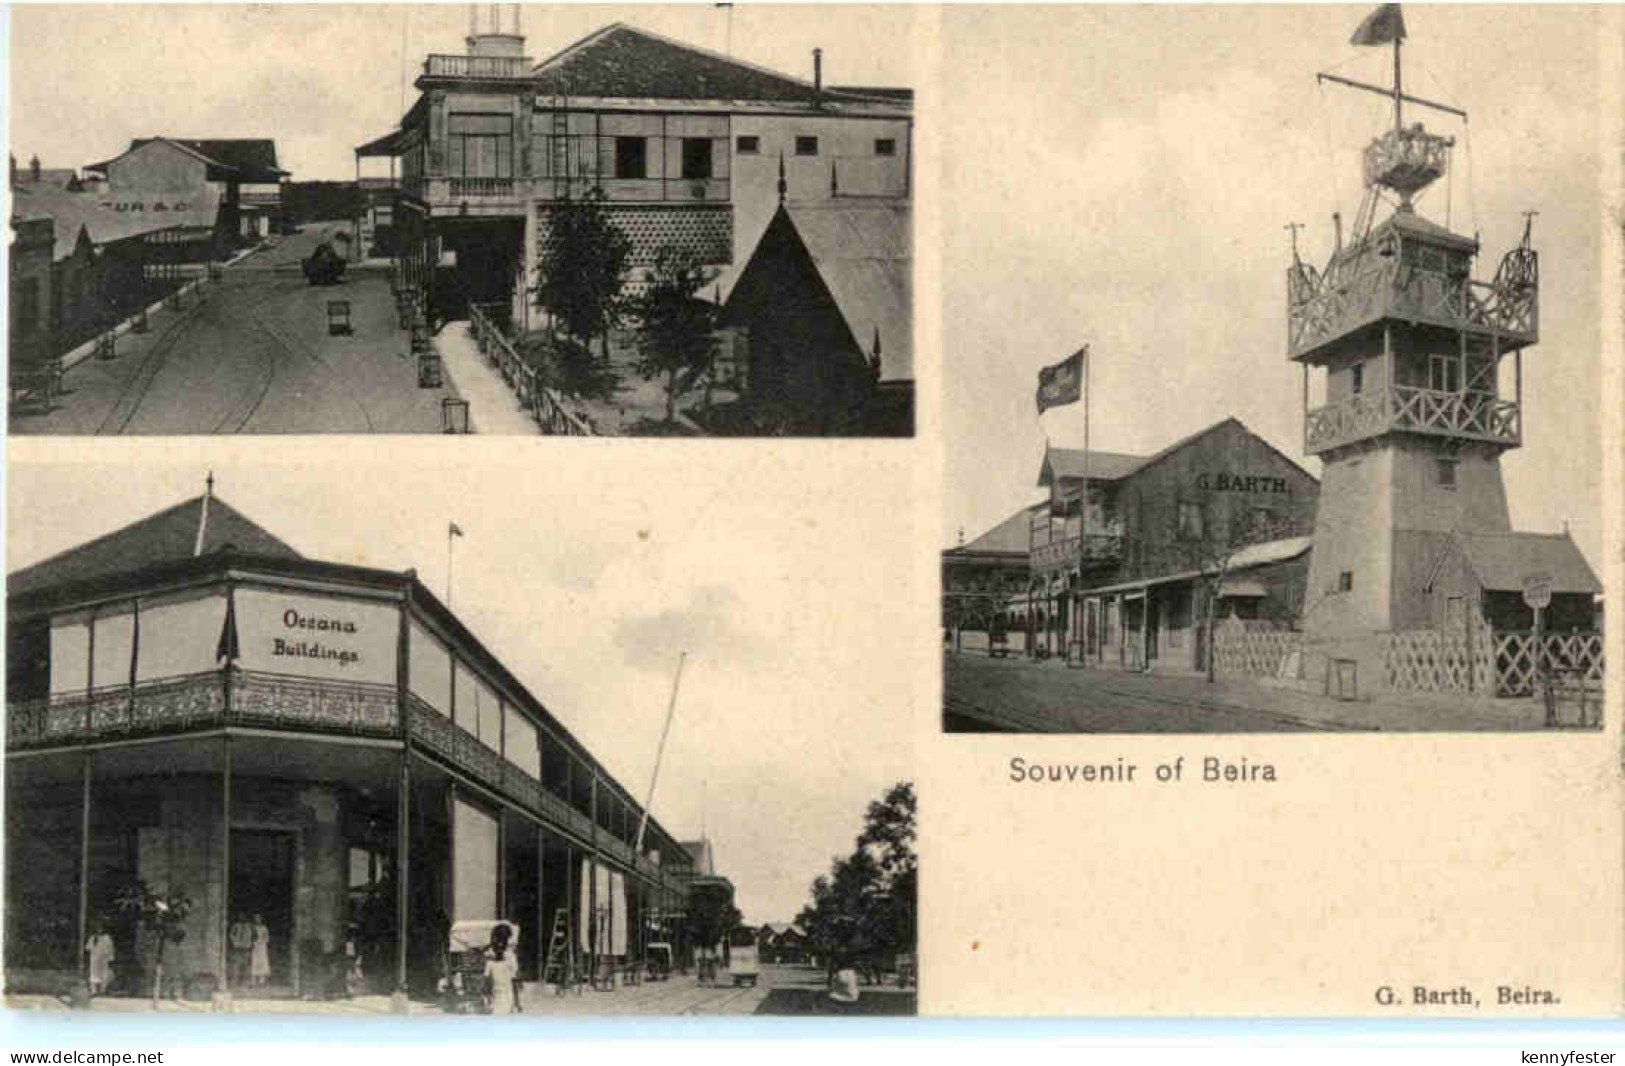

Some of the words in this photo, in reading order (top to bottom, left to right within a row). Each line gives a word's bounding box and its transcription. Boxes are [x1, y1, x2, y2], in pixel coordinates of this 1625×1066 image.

[272, 638, 359, 667] Buildings
[1009, 757, 1137, 782] Souvenir
[1155, 756, 1184, 782] of
[1203, 756, 1278, 782] Beira
[1375, 985, 1402, 1006] G.
[1412, 985, 1481, 1009] Barth,
[1497, 985, 1562, 1005] Beira.
